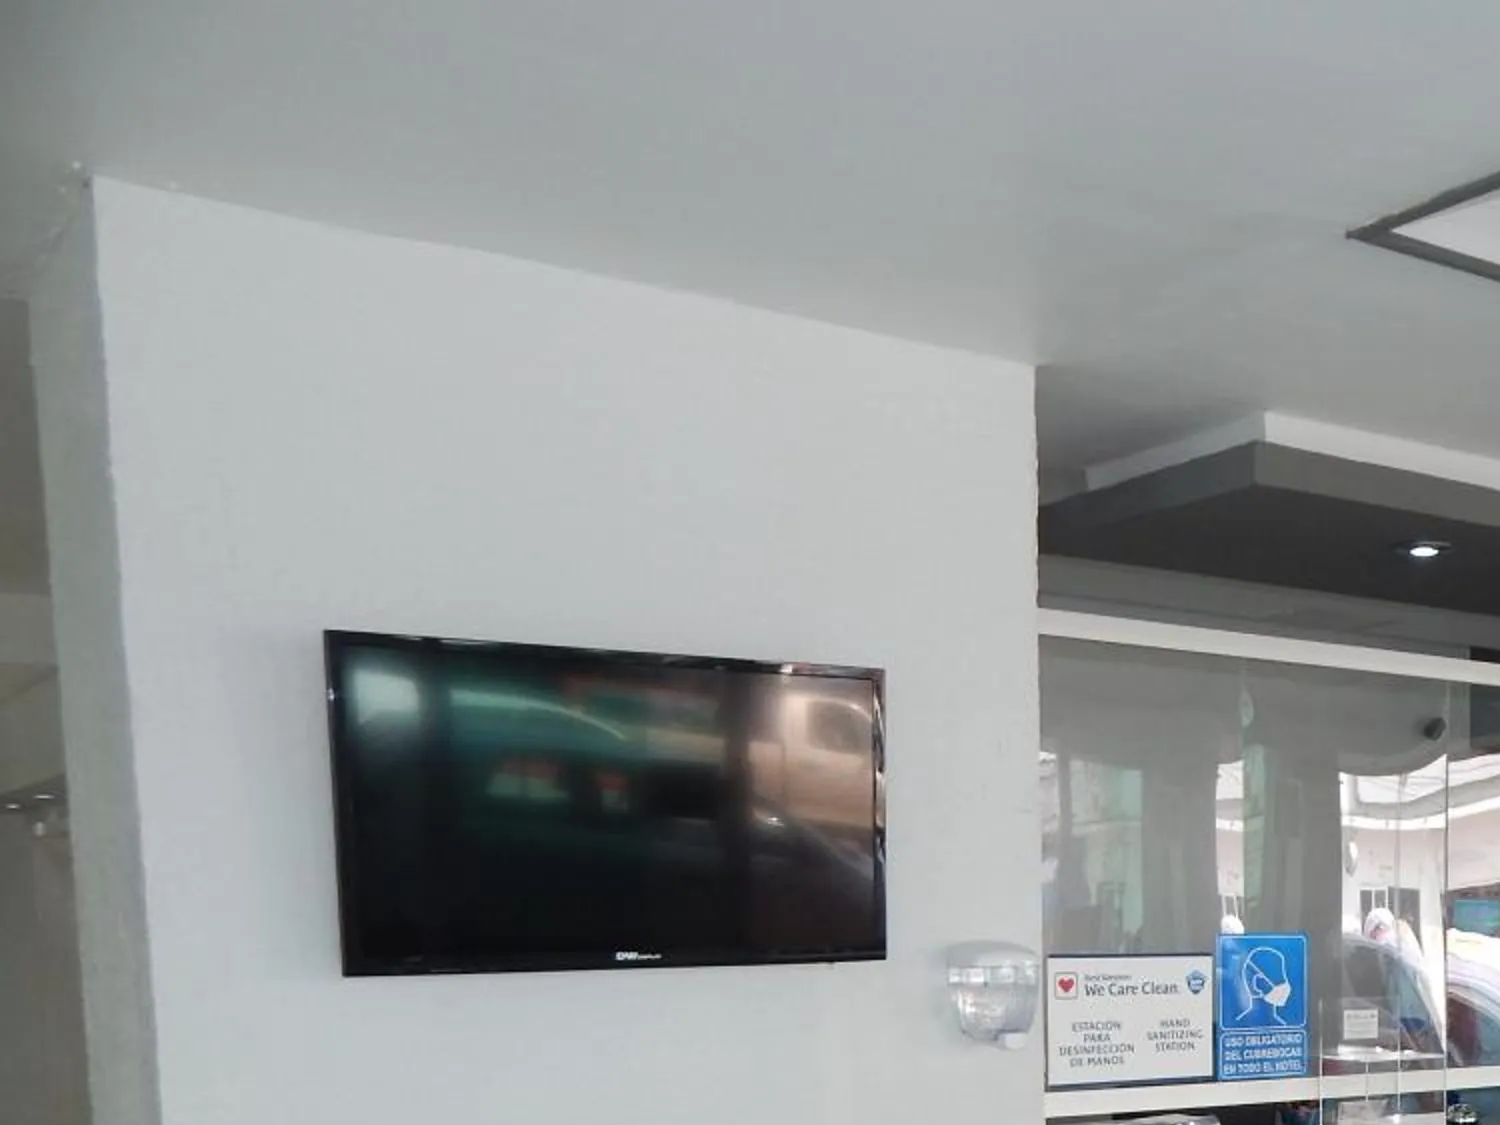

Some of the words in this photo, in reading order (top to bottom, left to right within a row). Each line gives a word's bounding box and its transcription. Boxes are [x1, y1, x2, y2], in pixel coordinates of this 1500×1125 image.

[1084, 984, 1105, 997] We
[1108, 983, 1139, 997] Care
[1141, 981, 1180, 995] Clean
[1083, 1033, 1111, 1043] PARA
[1070, 1058, 1083, 1068] DE
